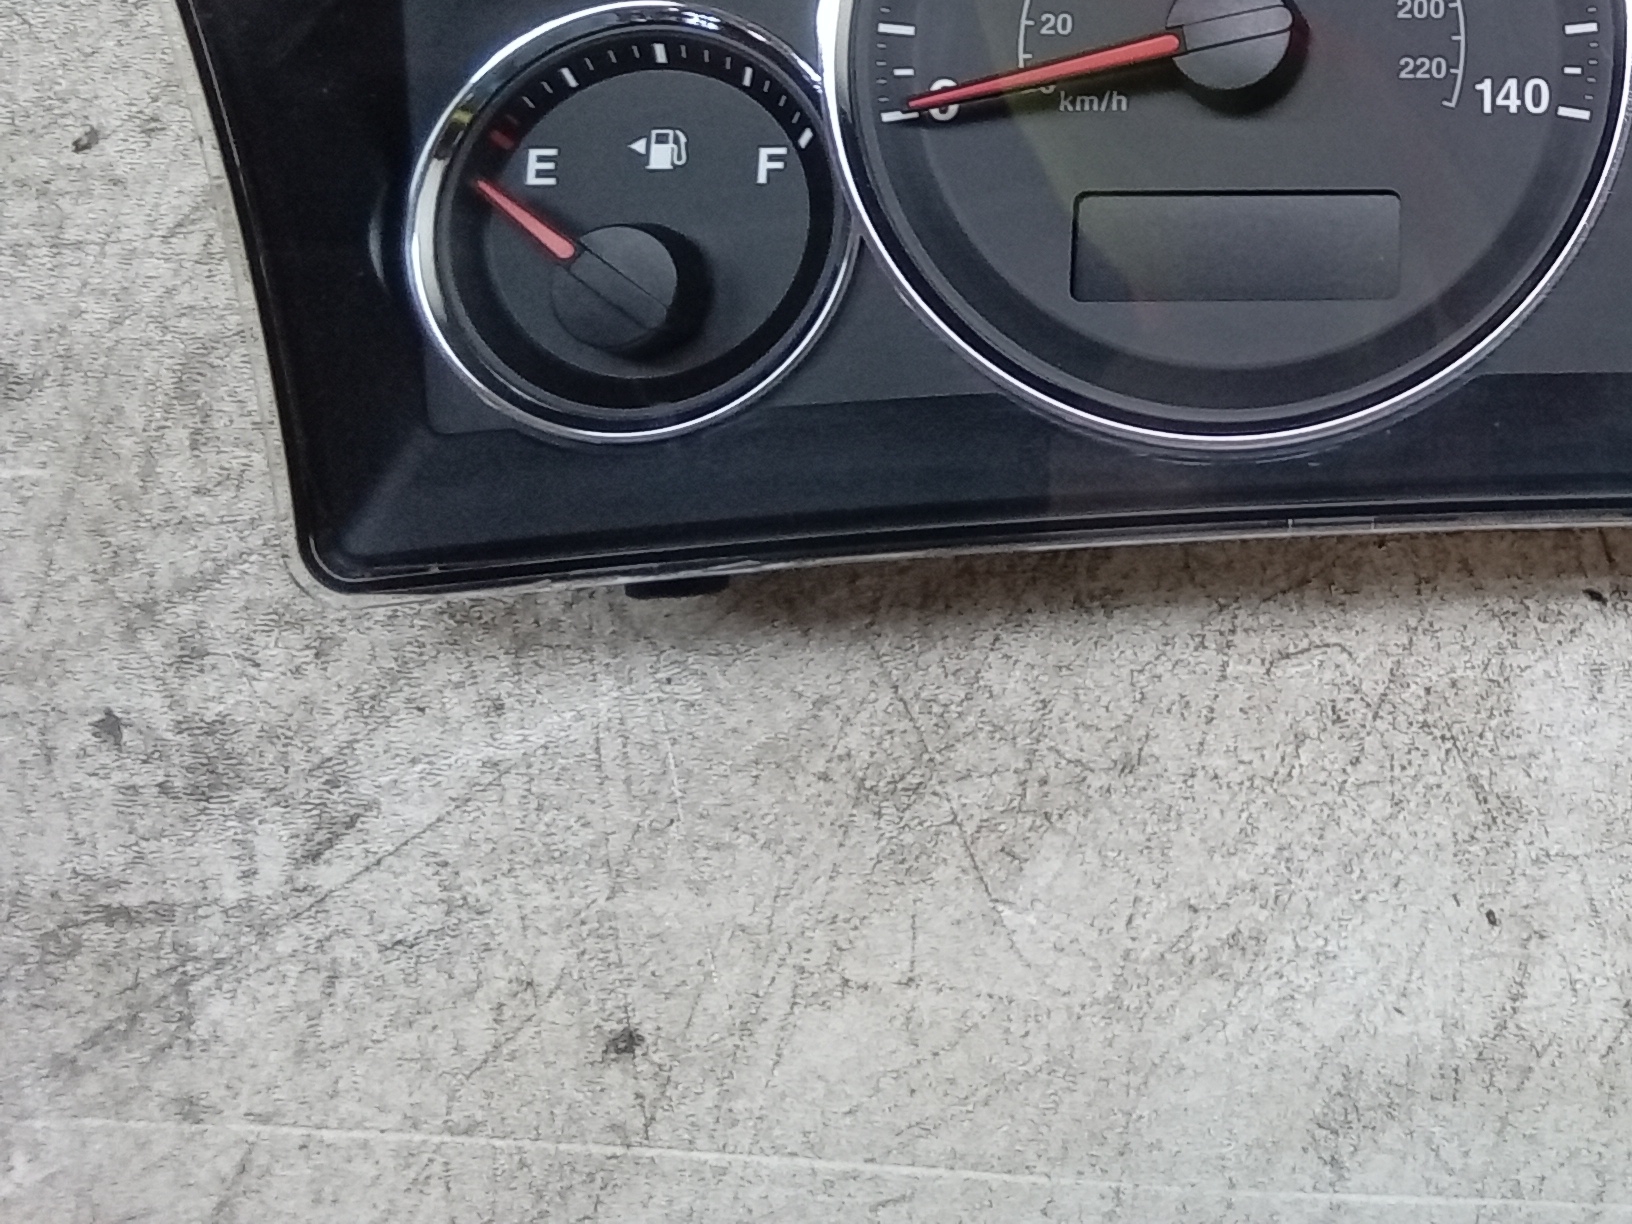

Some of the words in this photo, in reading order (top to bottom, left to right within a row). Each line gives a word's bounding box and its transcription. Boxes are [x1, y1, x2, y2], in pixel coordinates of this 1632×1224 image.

[1039, 13, 1073, 35] 20
[1398, 57, 1447, 79] 220
[1059, 90, 1129, 113] km/h
[1474, 77, 1550, 114] 140
[525, 148, 558, 186] E
[756, 147, 788, 184] F
